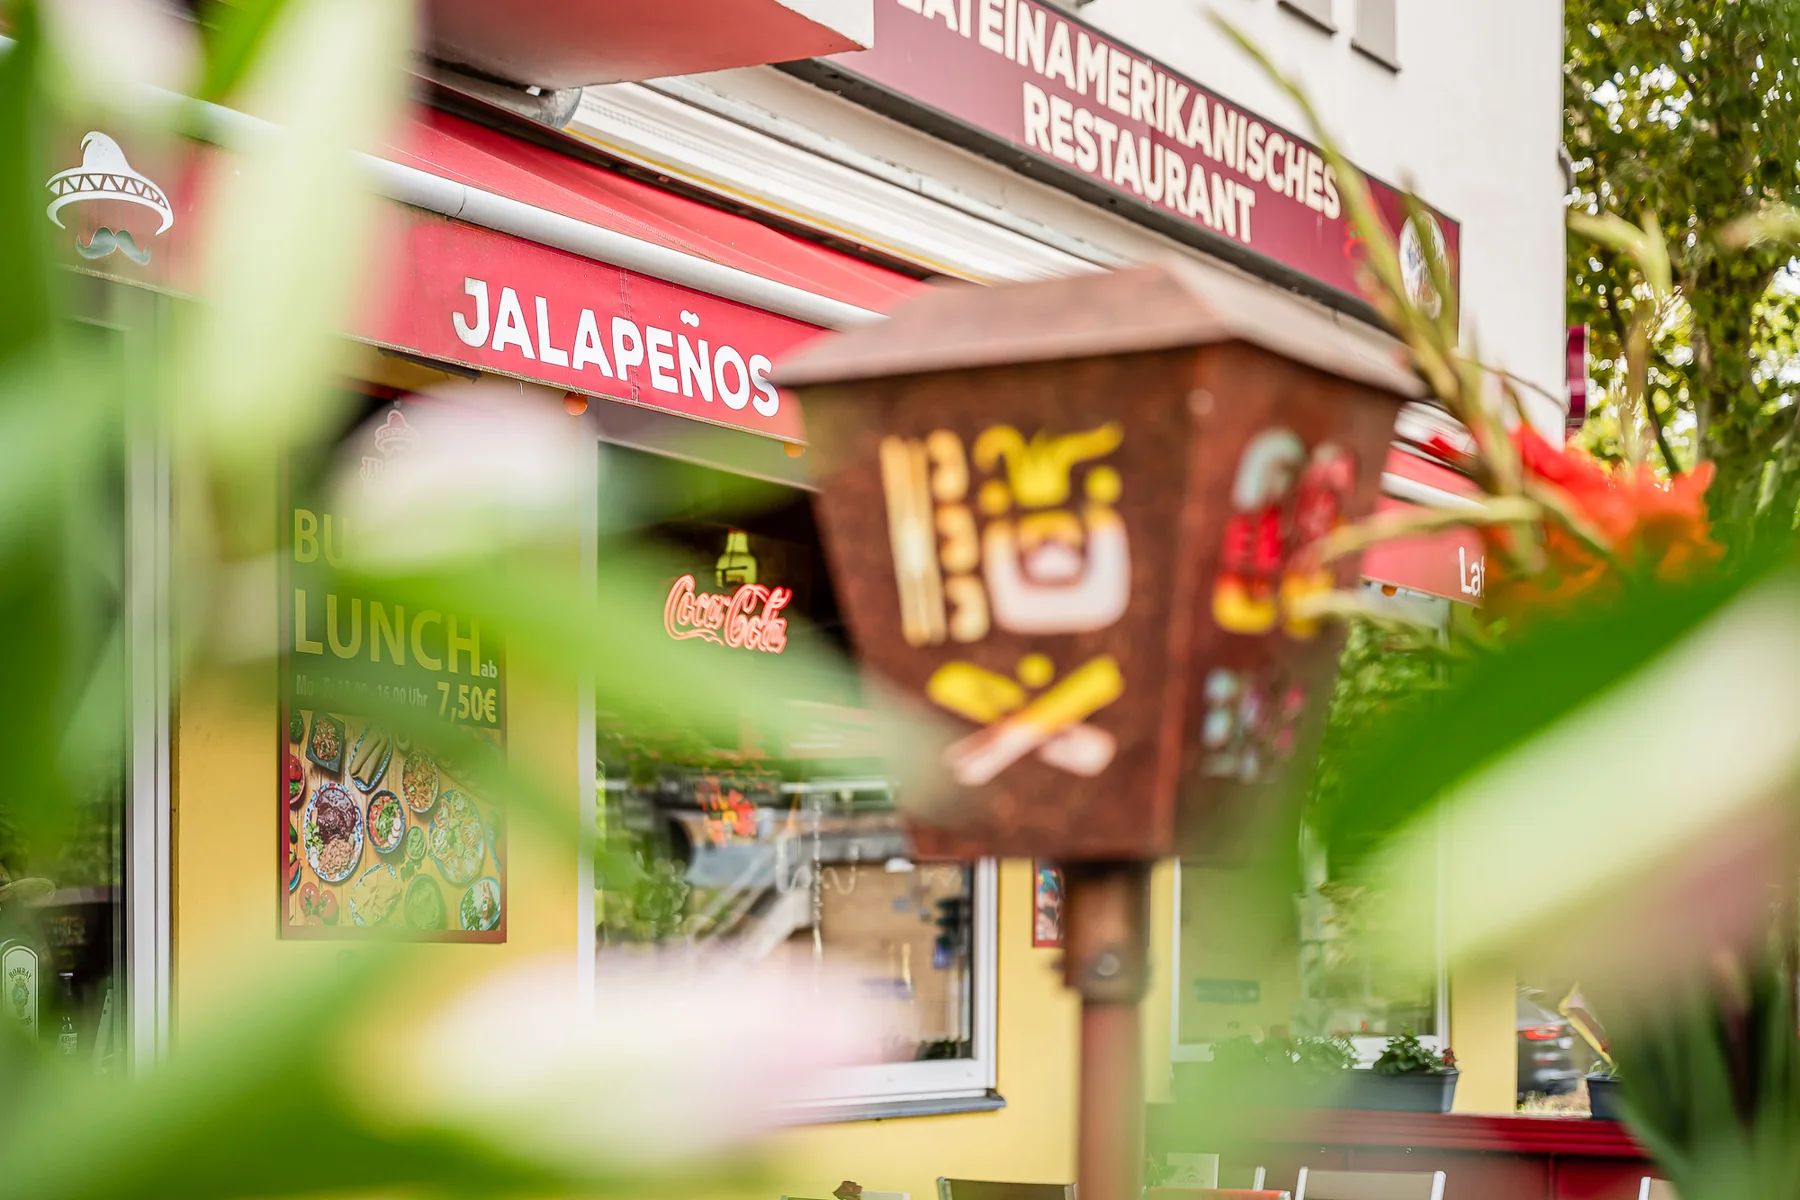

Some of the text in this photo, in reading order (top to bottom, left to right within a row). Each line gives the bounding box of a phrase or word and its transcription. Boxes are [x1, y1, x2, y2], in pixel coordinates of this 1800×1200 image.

[896, 0, 1341, 219] EINAMERIKANISCHES
[1023, 82, 1256, 244] RESTAURANT
[452, 276, 780, 417] JALAPEÑOS
[294, 588, 480, 677] LUNCH
[481, 660, 498, 678] ab
[377, 684, 406, 704] 1600
[408, 686, 428, 707] Uhr
[437, 681, 497, 723] 7,50€
